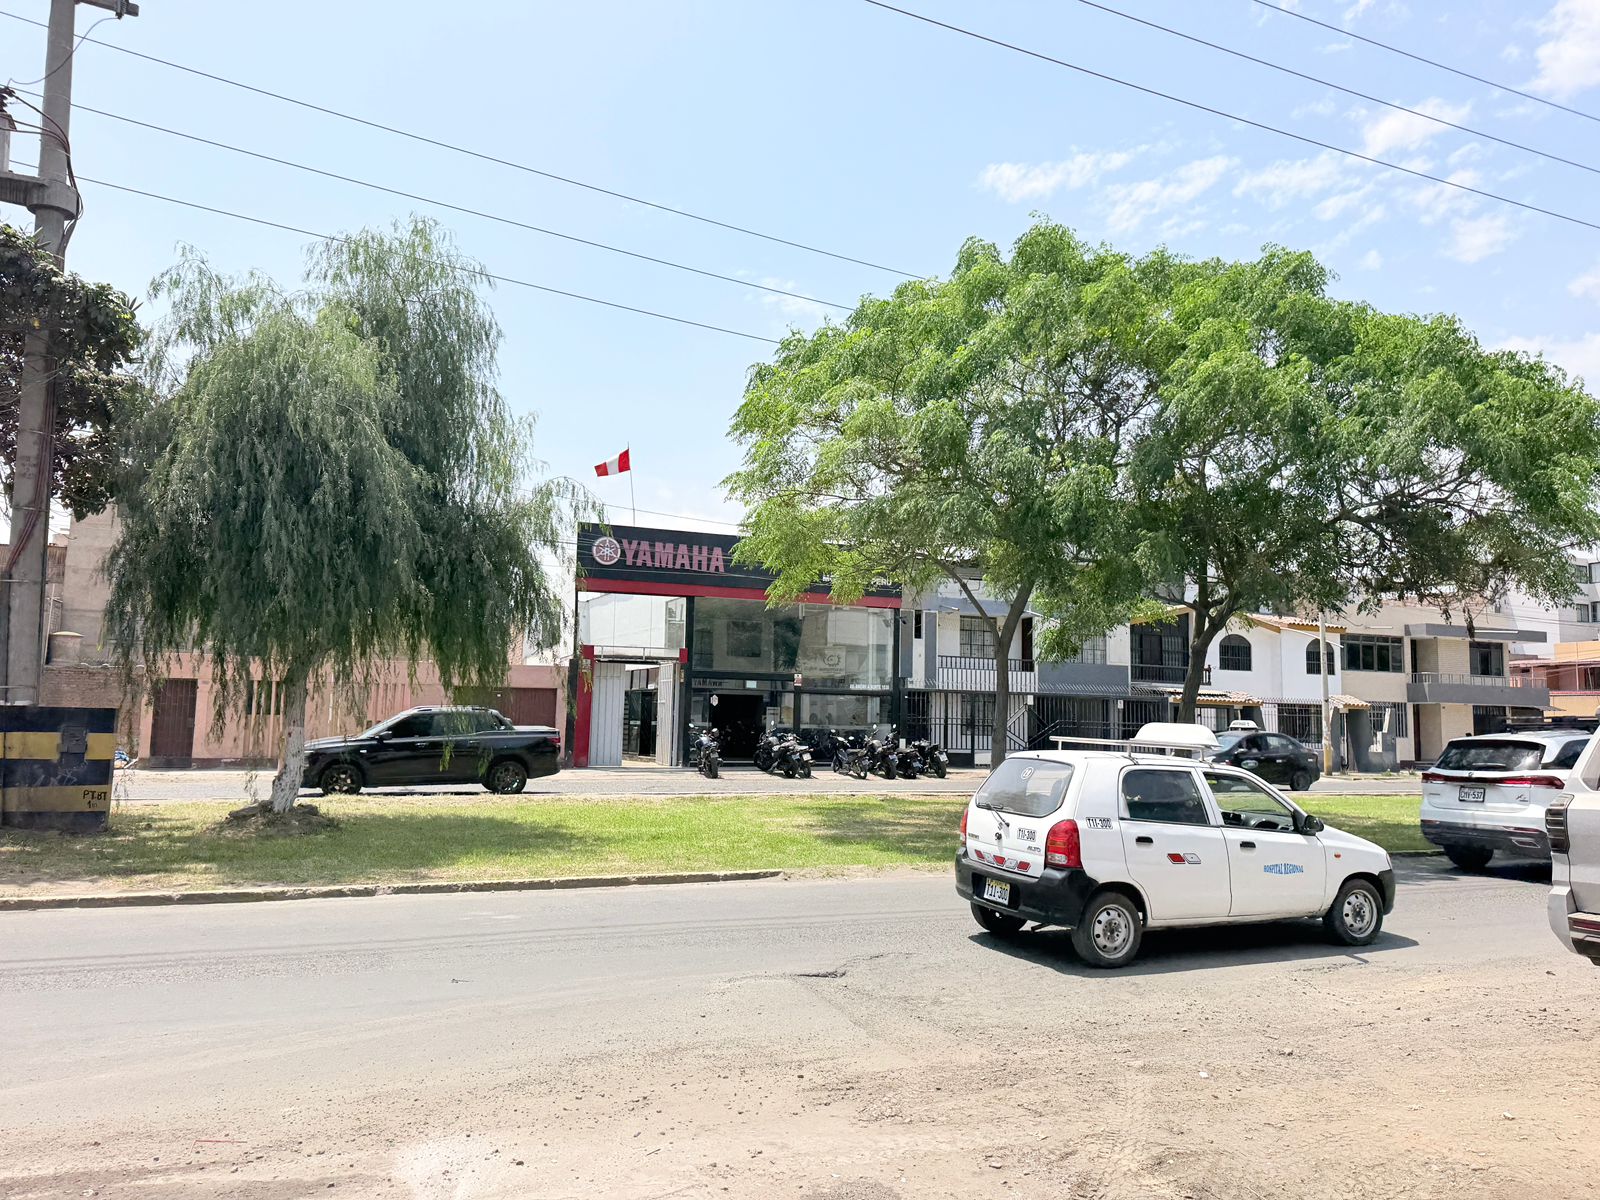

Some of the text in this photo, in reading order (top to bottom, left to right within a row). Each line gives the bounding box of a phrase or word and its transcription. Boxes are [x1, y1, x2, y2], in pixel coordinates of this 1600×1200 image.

[622, 538, 725, 573] YAMAHA
[1264, 863, 1304, 875] HOSPITAL REGIONAL
